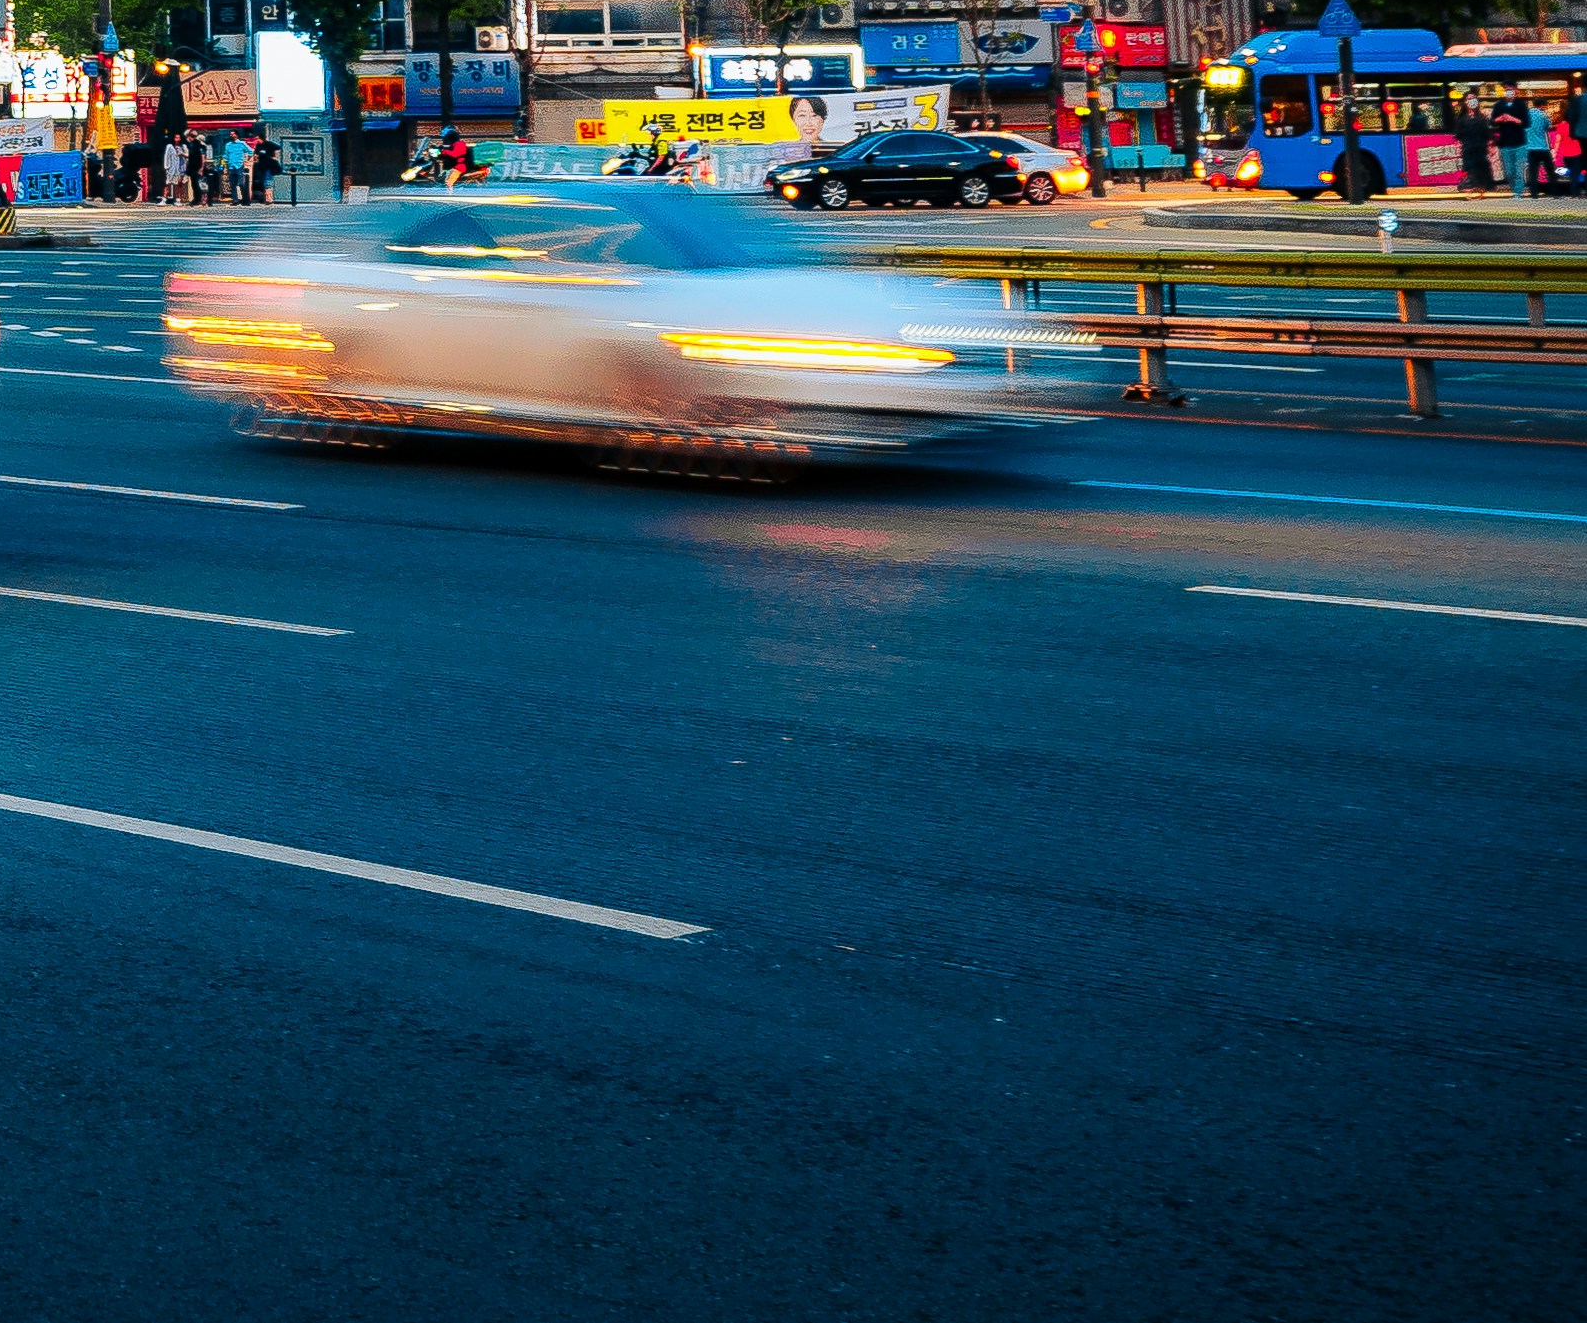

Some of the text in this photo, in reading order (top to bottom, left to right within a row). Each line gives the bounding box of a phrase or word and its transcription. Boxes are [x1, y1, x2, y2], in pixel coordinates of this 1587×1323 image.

[412, 60, 511, 83] 방장비
[186, 78, 249, 102] ISAAC
[686, 112, 724, 132] 전면
[728, 110, 766, 130] 수정
[913, 93, 940, 131] 3
